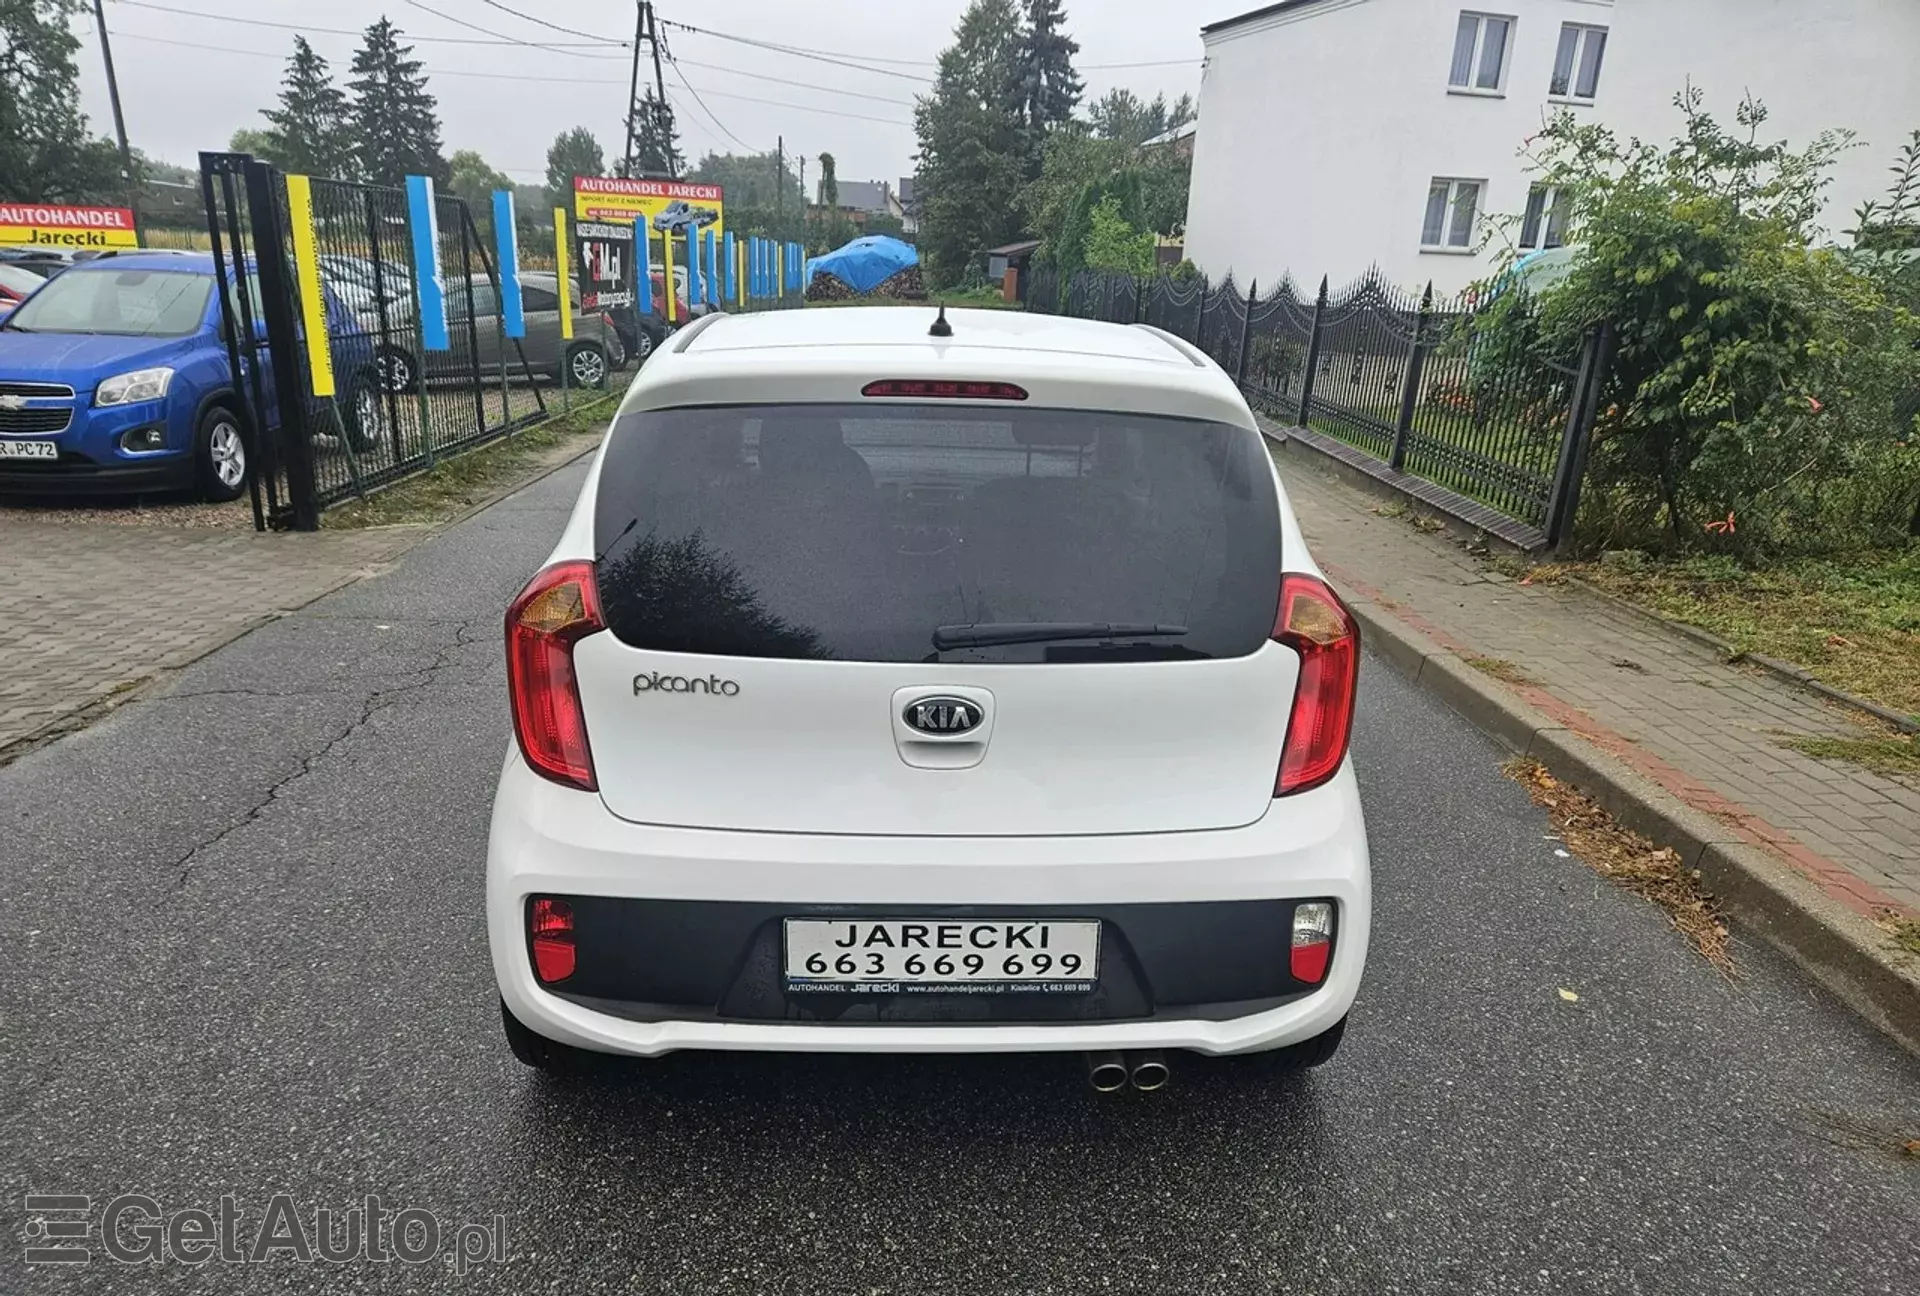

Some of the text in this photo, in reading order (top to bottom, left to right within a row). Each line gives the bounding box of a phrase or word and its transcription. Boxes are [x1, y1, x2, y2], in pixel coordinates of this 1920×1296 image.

[580, 179, 717, 198] AUTOHANDEL JARECKI
[0, 207, 125, 227] AUTOHANDEL
[27, 229, 107, 246] Jarecki
[633, 671, 741, 696] picanto
[916, 705, 971, 729] KIA
[834, 924, 1050, 949] JARECKI
[805, 952, 1082, 976] 663 669 699
[788, 983, 846, 992] AUTOHANDEL
[850, 982, 900, 993] Jarecki
